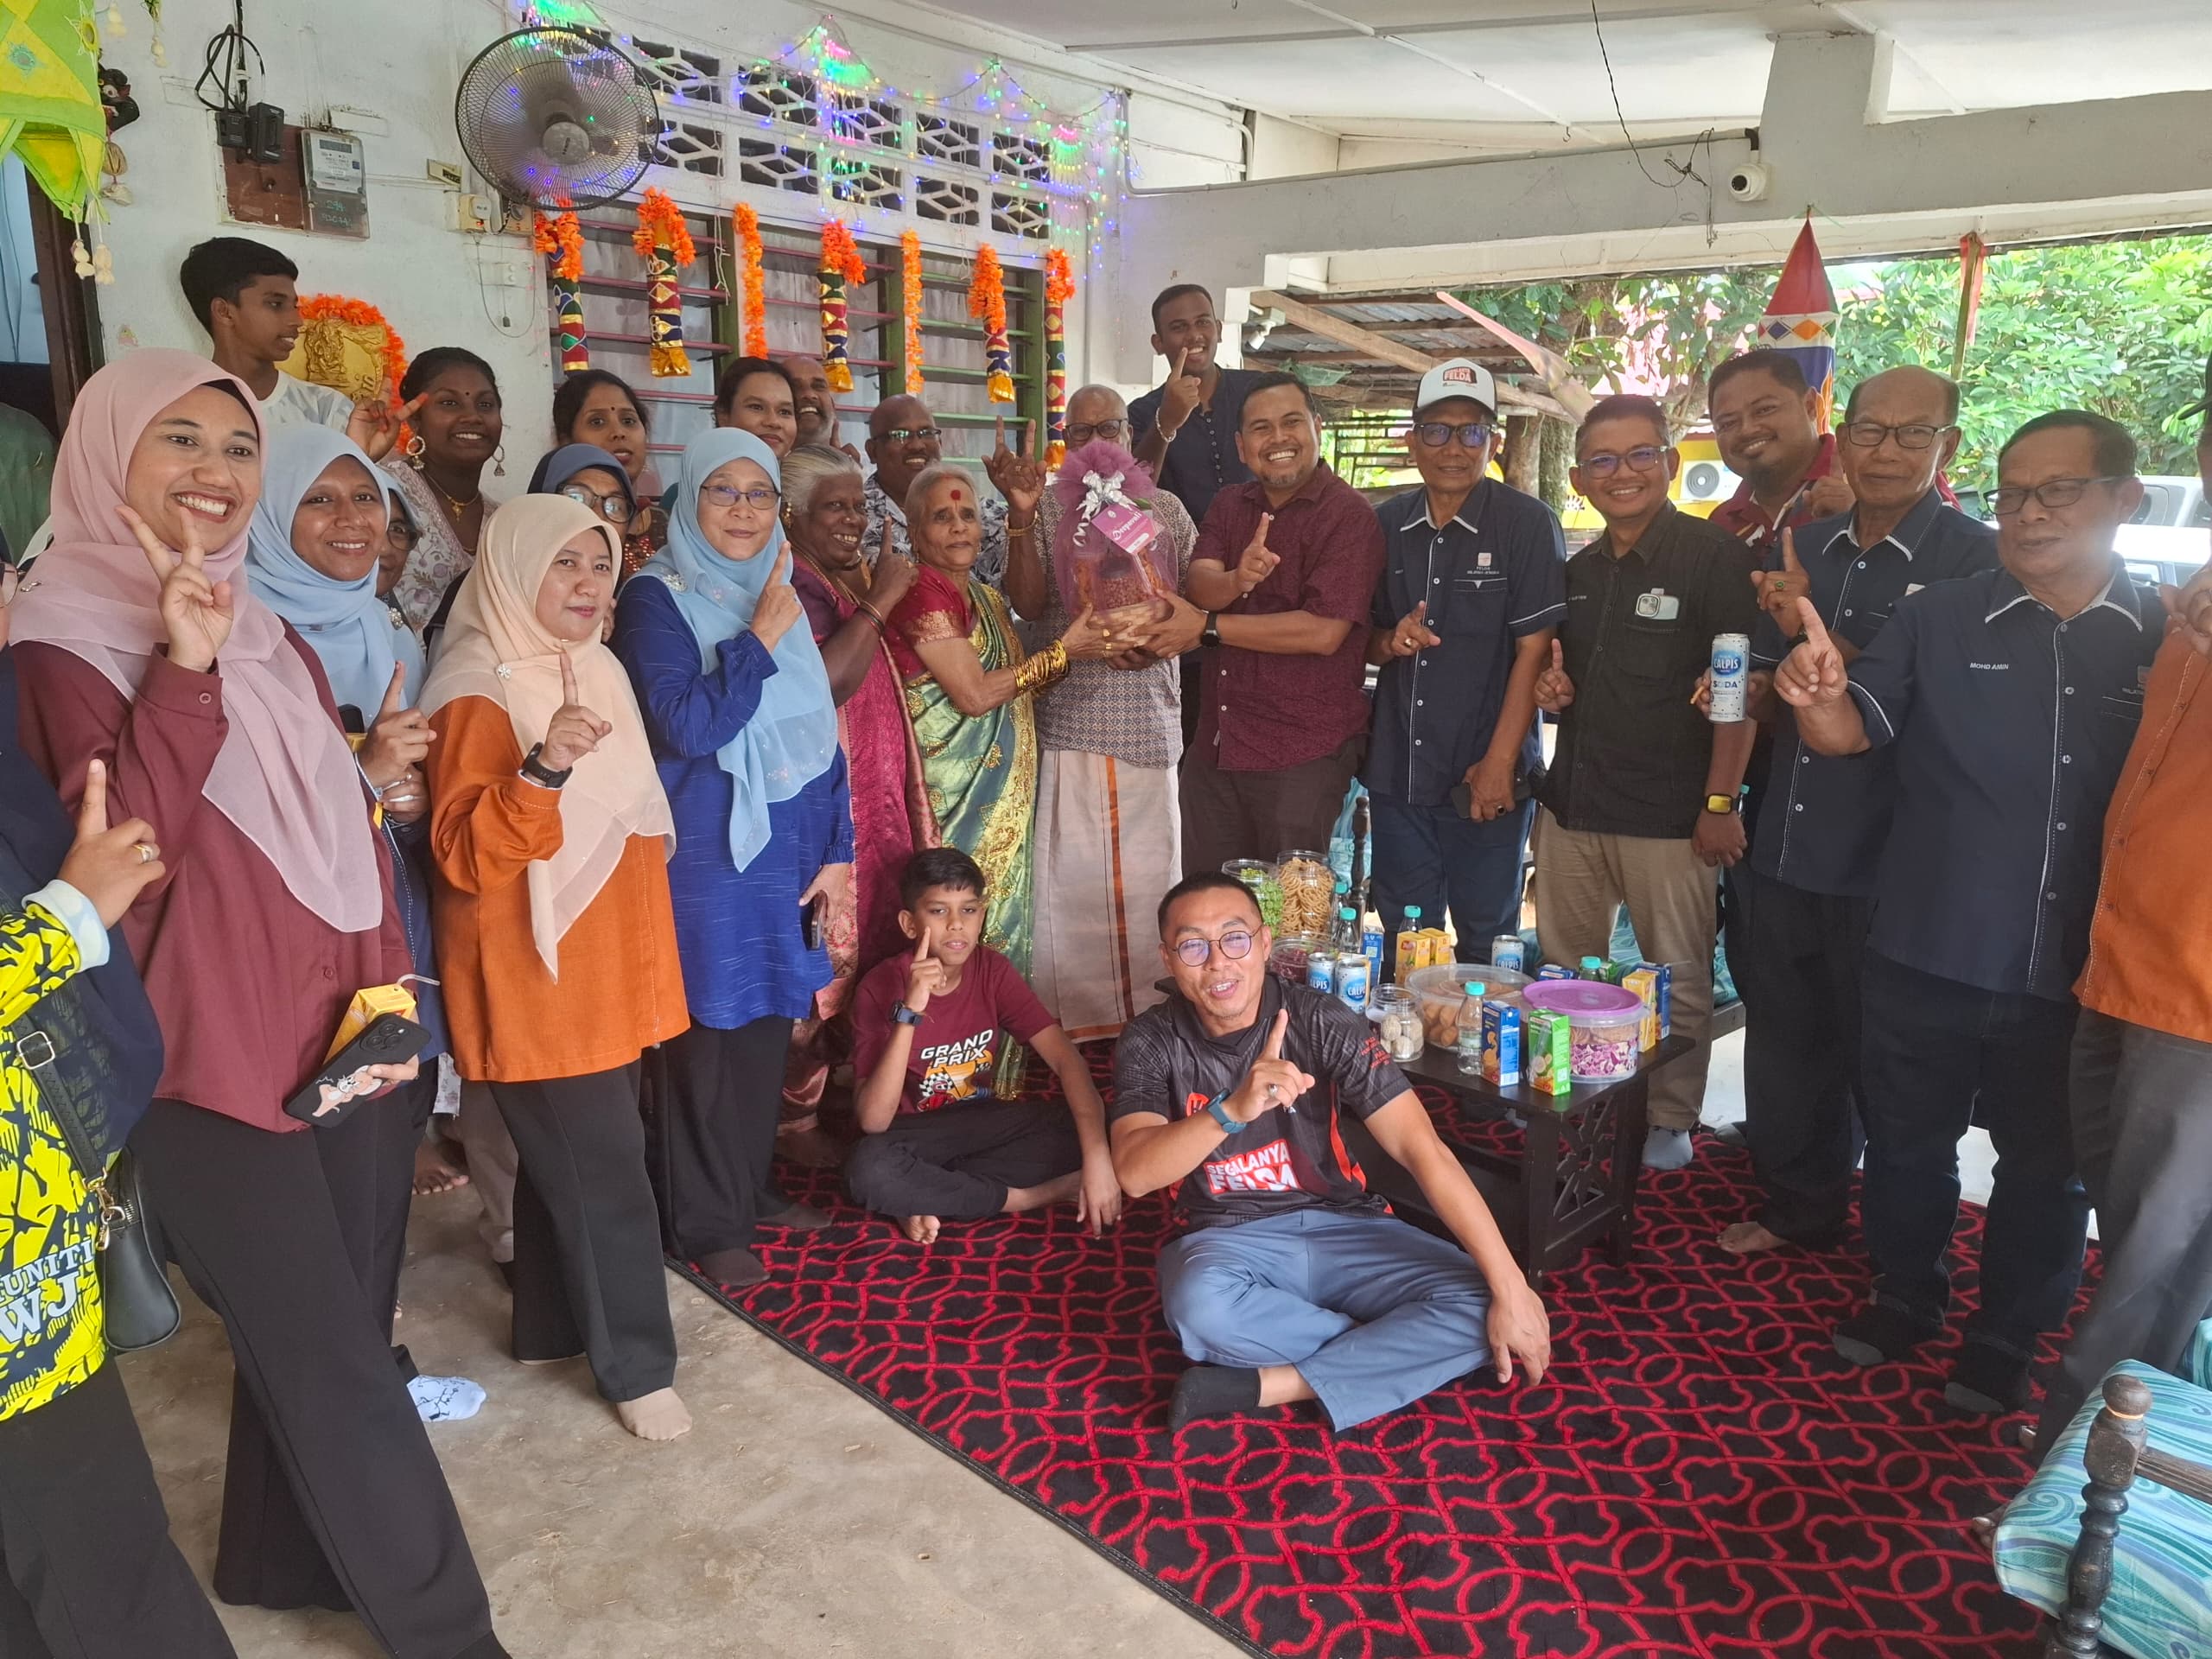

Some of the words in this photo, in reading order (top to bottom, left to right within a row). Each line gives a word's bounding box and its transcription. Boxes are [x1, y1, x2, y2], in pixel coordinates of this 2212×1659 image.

[1444, 372, 1472, 383] FELDA
[1713, 657, 1738, 670] CALPIS
[1713, 680, 1738, 689] SODA
[920, 1029, 994, 1059] GRAND
[933, 1044, 987, 1068] PRIX
[1206, 1141, 1291, 1176] SEGALANYA
[0, 1239, 95, 1304] UNITI
[0, 1271, 79, 1343] WJ
